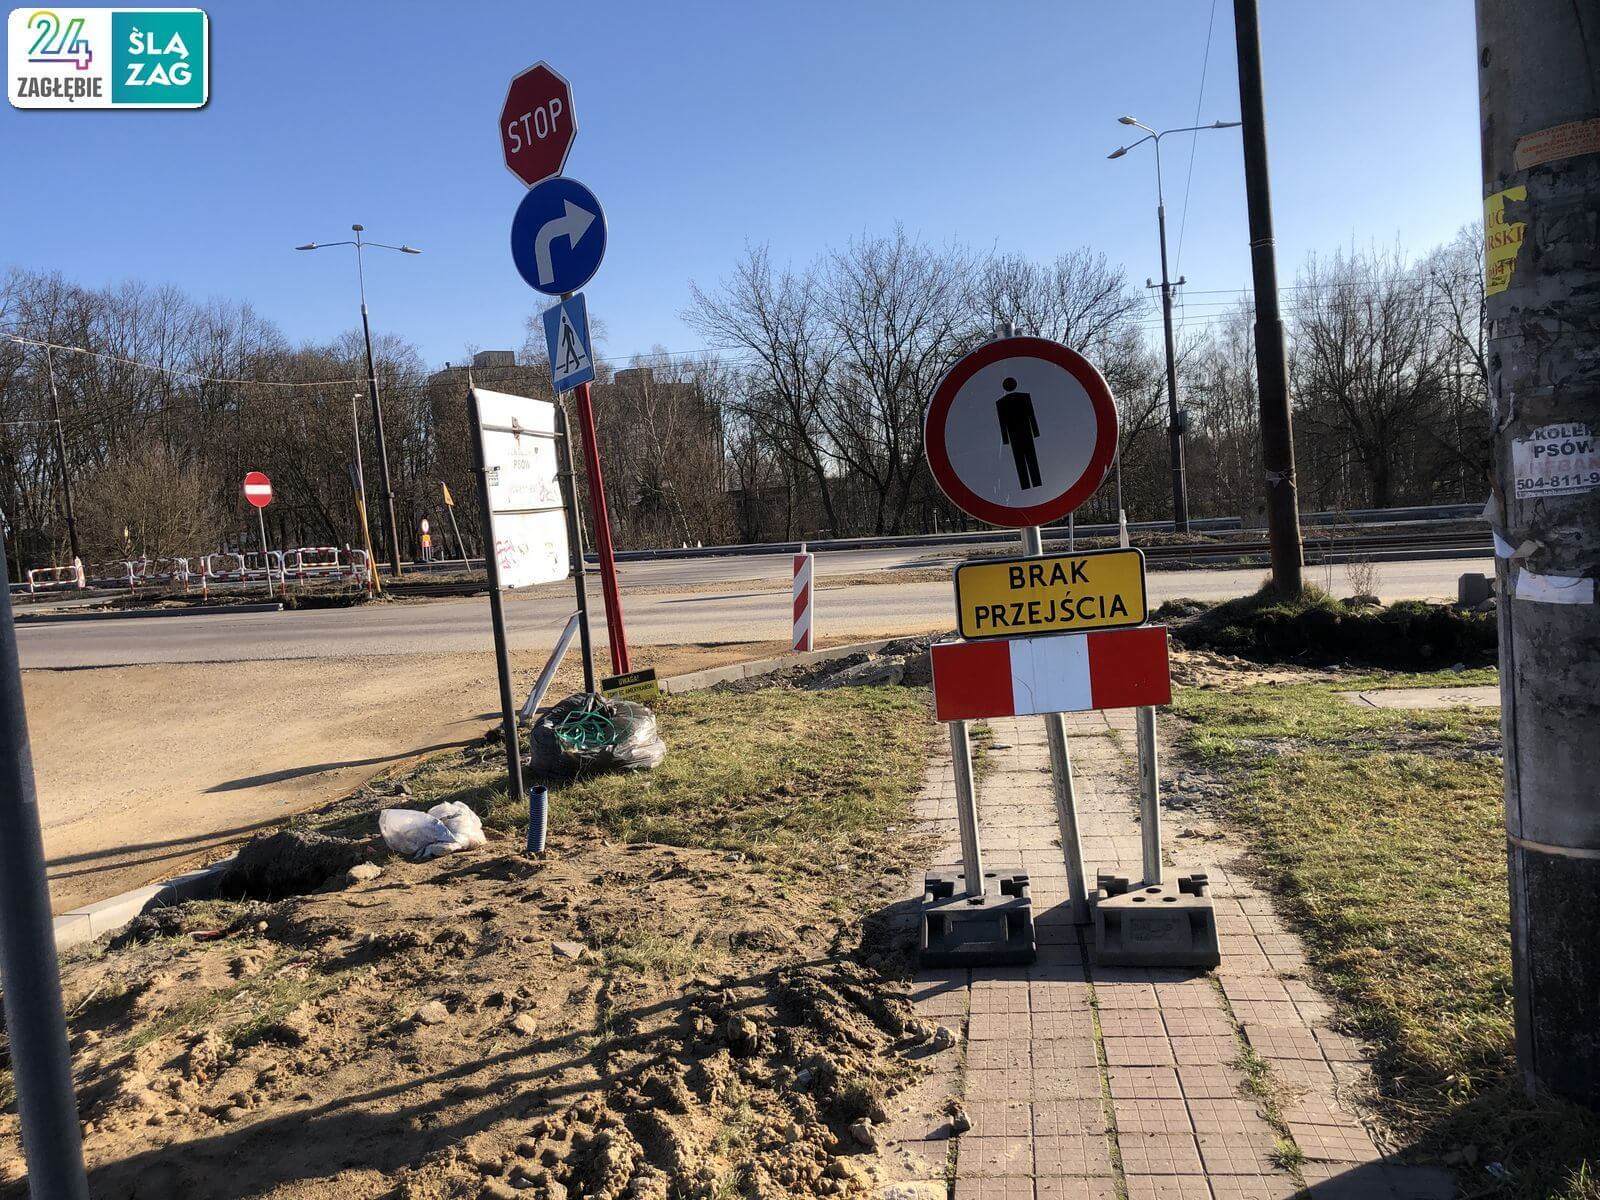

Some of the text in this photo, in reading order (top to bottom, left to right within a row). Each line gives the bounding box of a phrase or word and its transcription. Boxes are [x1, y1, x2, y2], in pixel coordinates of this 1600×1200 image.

[508, 97, 563, 154] STOP
[1009, 560, 1090, 590] BRAK
[975, 591, 1129, 629] PRZEJŚCIA
